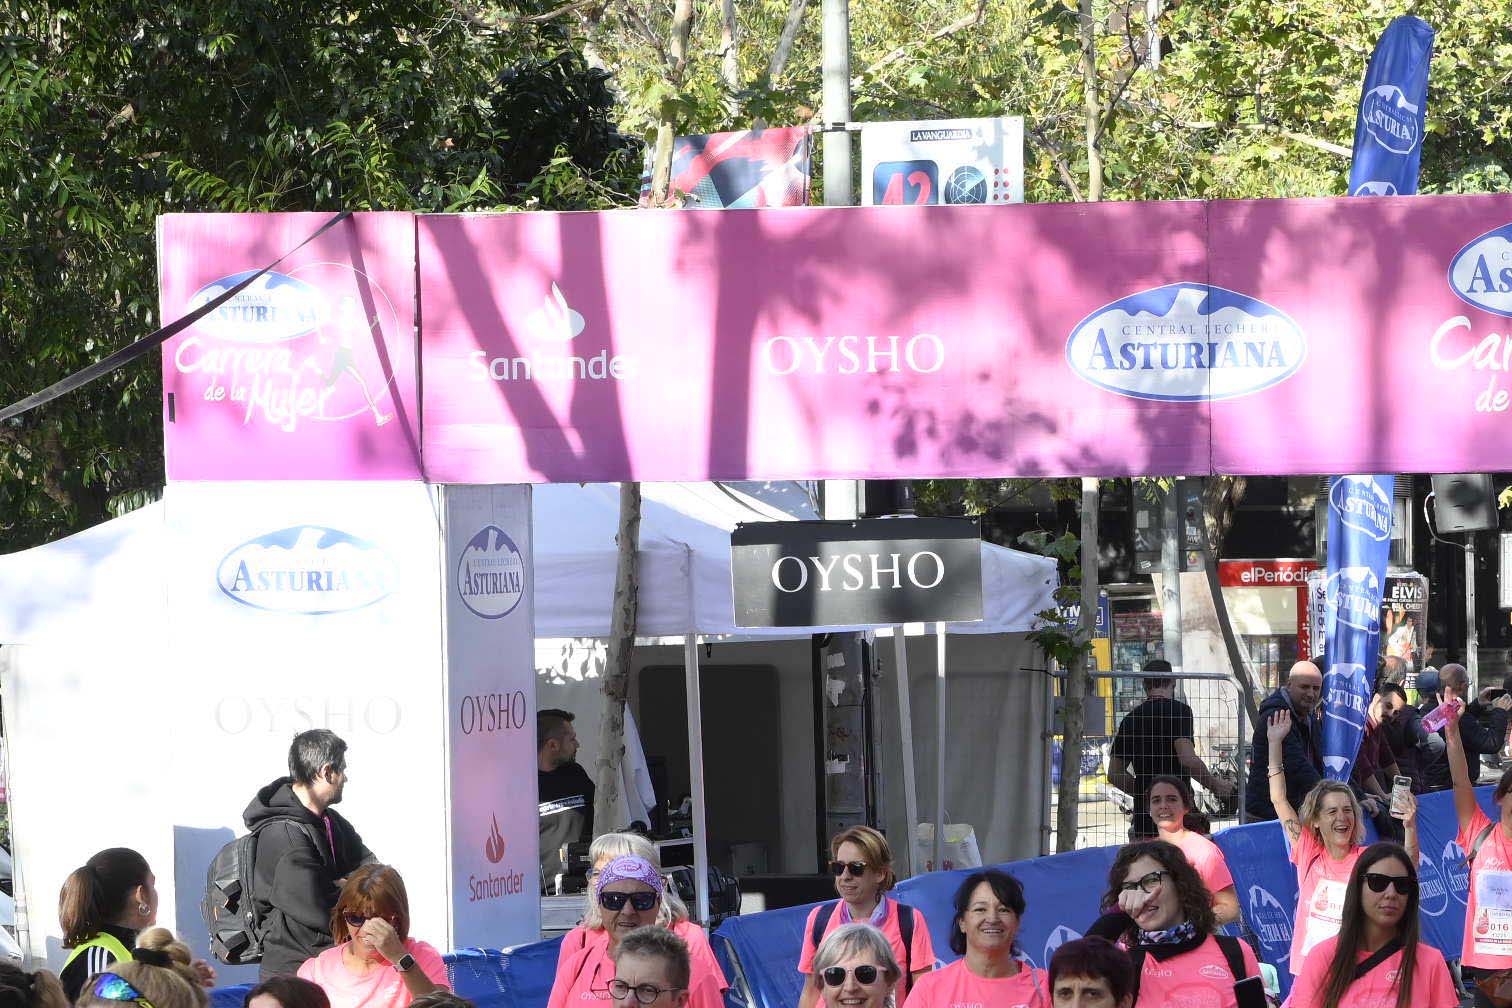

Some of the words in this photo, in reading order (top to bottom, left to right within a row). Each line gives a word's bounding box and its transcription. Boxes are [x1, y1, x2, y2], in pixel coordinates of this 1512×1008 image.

[1088, 327, 1287, 370] ASTURIANA
[1122, 324, 1196, 336] CENTRAL
[175, 336, 293, 374] Carrera
[765, 334, 946, 375] OYSHO
[204, 376, 226, 401] de
[243, 369, 337, 433] Mujer
[1475, 374, 1509, 412] de
[463, 562, 521, 596] ASTURIANA
[771, 551, 945, 593] OYSHO
[1391, 587, 1423, 599] ELVIS
[215, 694, 405, 735] OYSHO
[461, 689, 527, 735] OYSHO
[469, 872, 525, 902] Santander
[1490, 923, 1509, 931] 016
